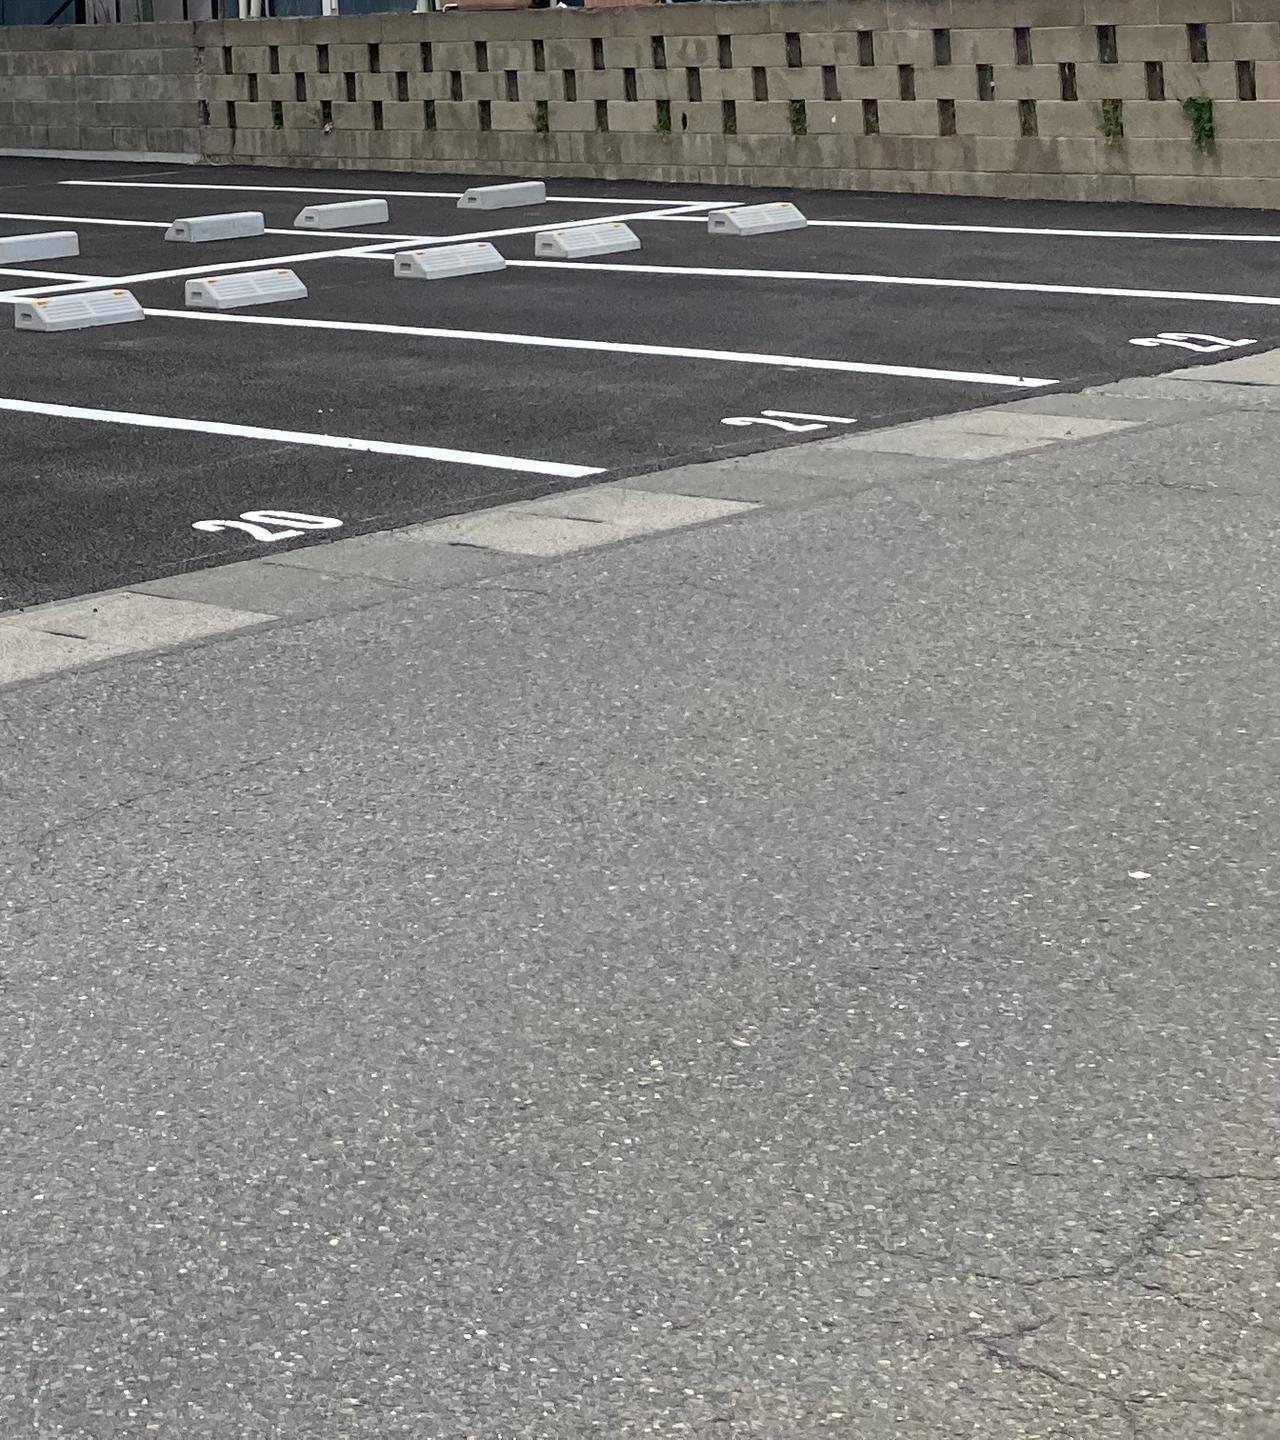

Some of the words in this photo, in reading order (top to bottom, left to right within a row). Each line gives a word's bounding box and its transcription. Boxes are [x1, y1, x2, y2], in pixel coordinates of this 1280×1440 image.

[1128, 332, 1259, 353] 22
[720, 409, 859, 432] 21
[191, 509, 344, 543] 20
